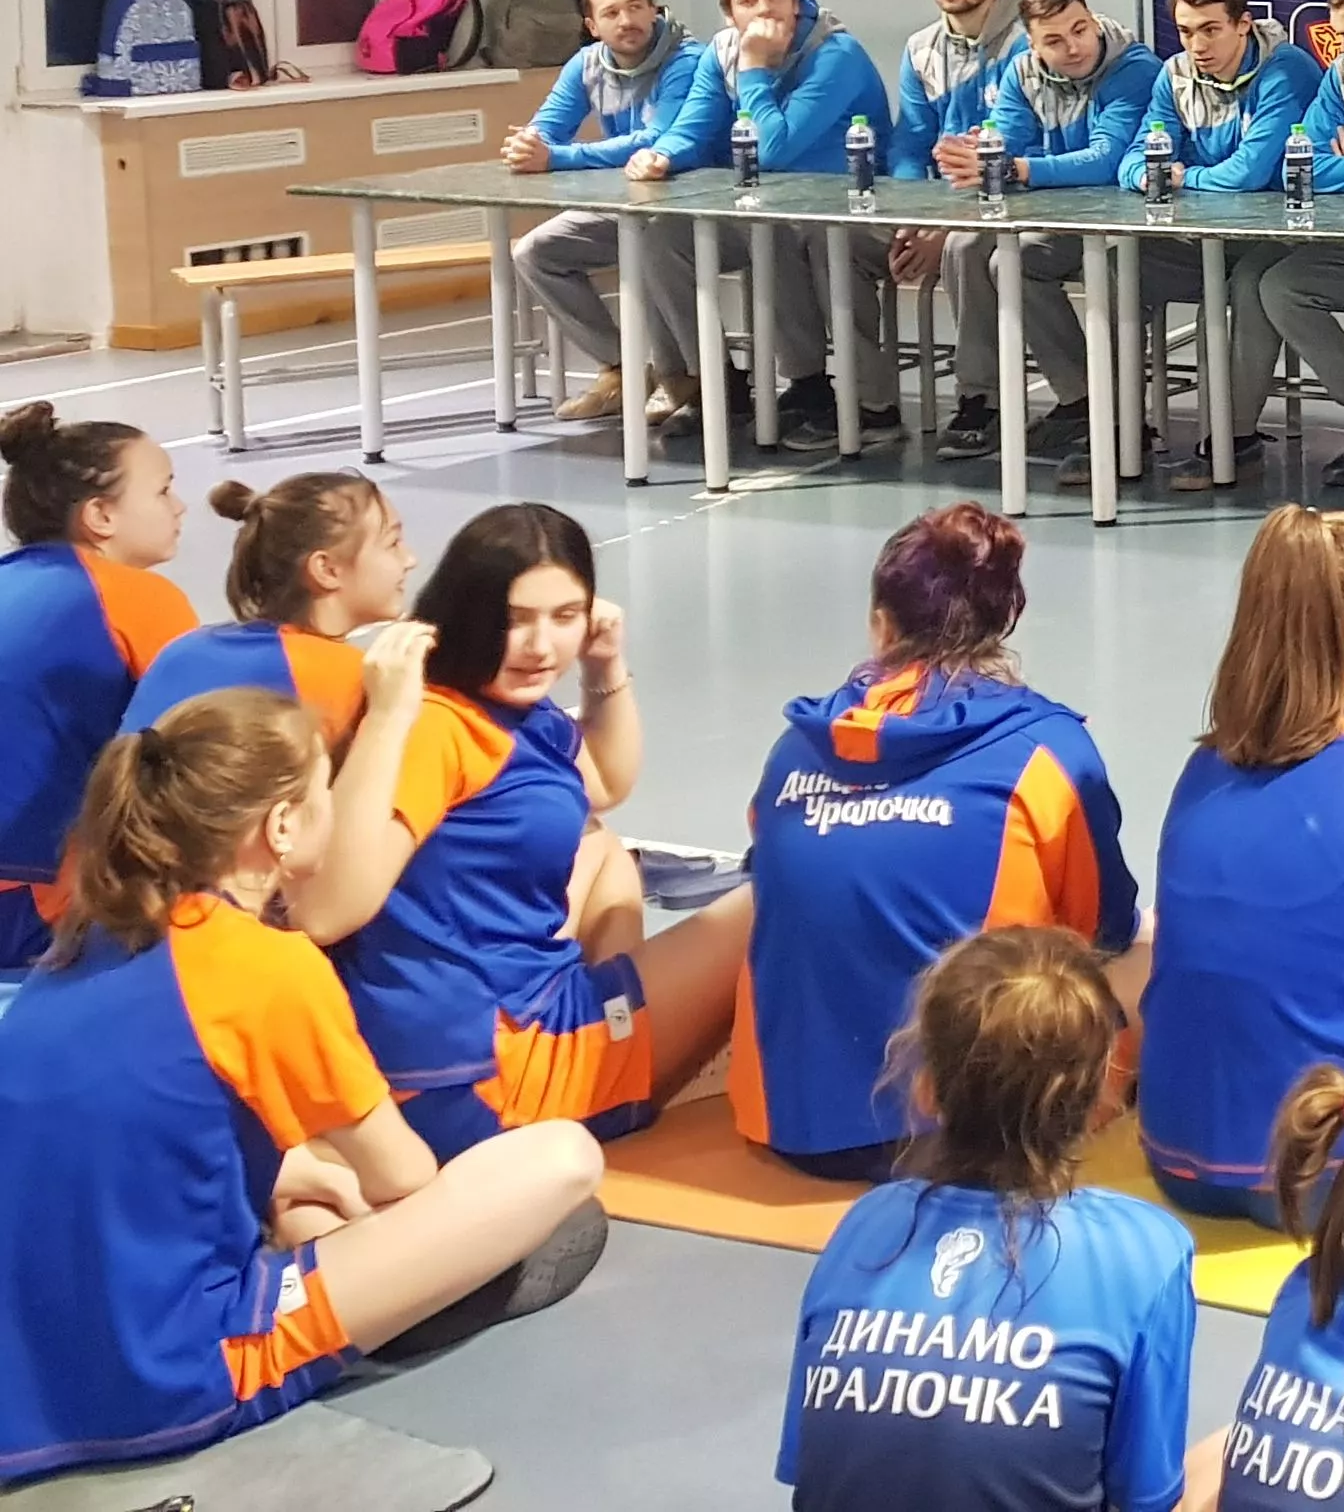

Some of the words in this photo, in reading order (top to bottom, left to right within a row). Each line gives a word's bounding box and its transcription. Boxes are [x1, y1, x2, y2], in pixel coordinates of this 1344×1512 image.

[804, 794, 954, 836] Уралочка
[820, 1308, 1058, 1371] ДИНАМО
[801, 1365, 1063, 1429] УРАЛОЧКА
